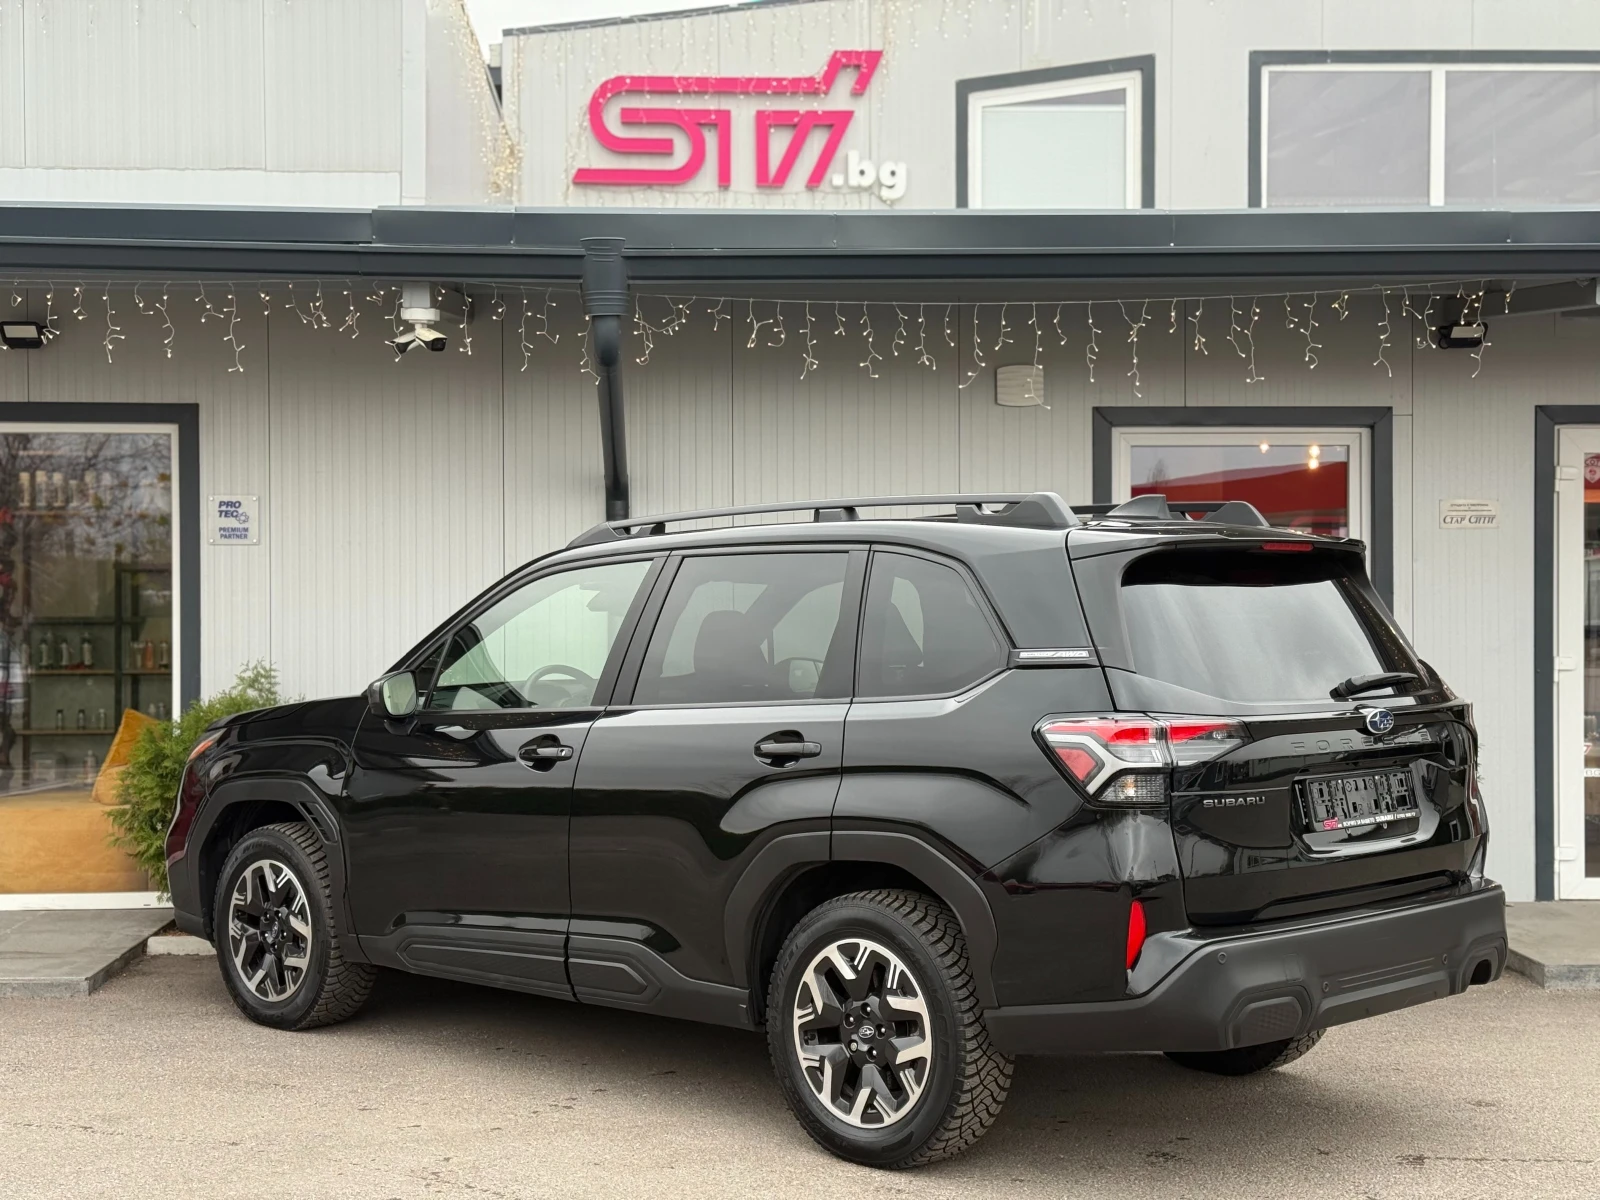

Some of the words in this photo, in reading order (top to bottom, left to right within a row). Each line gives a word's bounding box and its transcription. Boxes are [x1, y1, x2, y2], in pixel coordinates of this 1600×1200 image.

[218, 500, 242, 509] PRO
[217, 509, 240, 518] TEC
[1203, 796, 1266, 808] SUBARU
